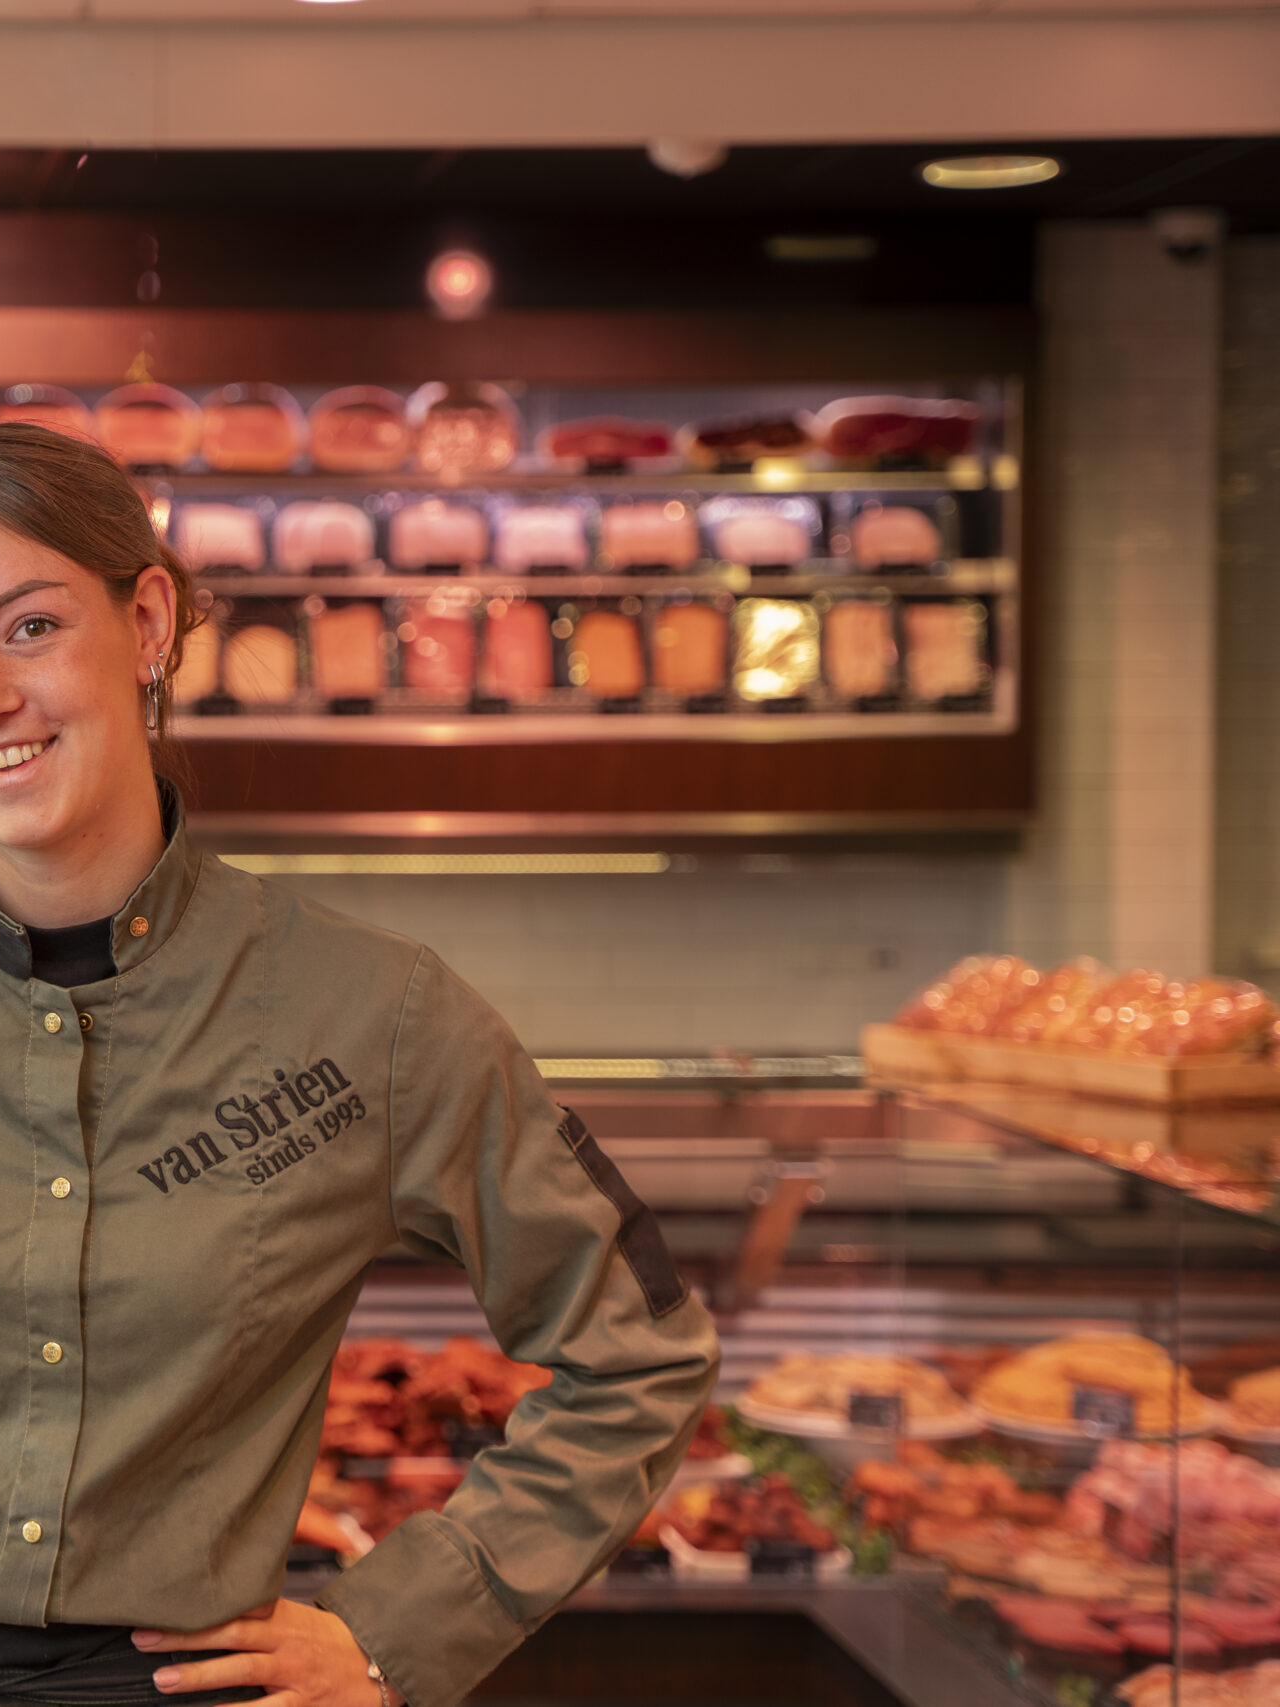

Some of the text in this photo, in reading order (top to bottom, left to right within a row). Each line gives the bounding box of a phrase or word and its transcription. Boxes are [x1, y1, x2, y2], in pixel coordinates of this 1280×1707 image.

[138, 1057, 352, 1194] van Strien
[245, 1094, 367, 1186] sinds 1993
